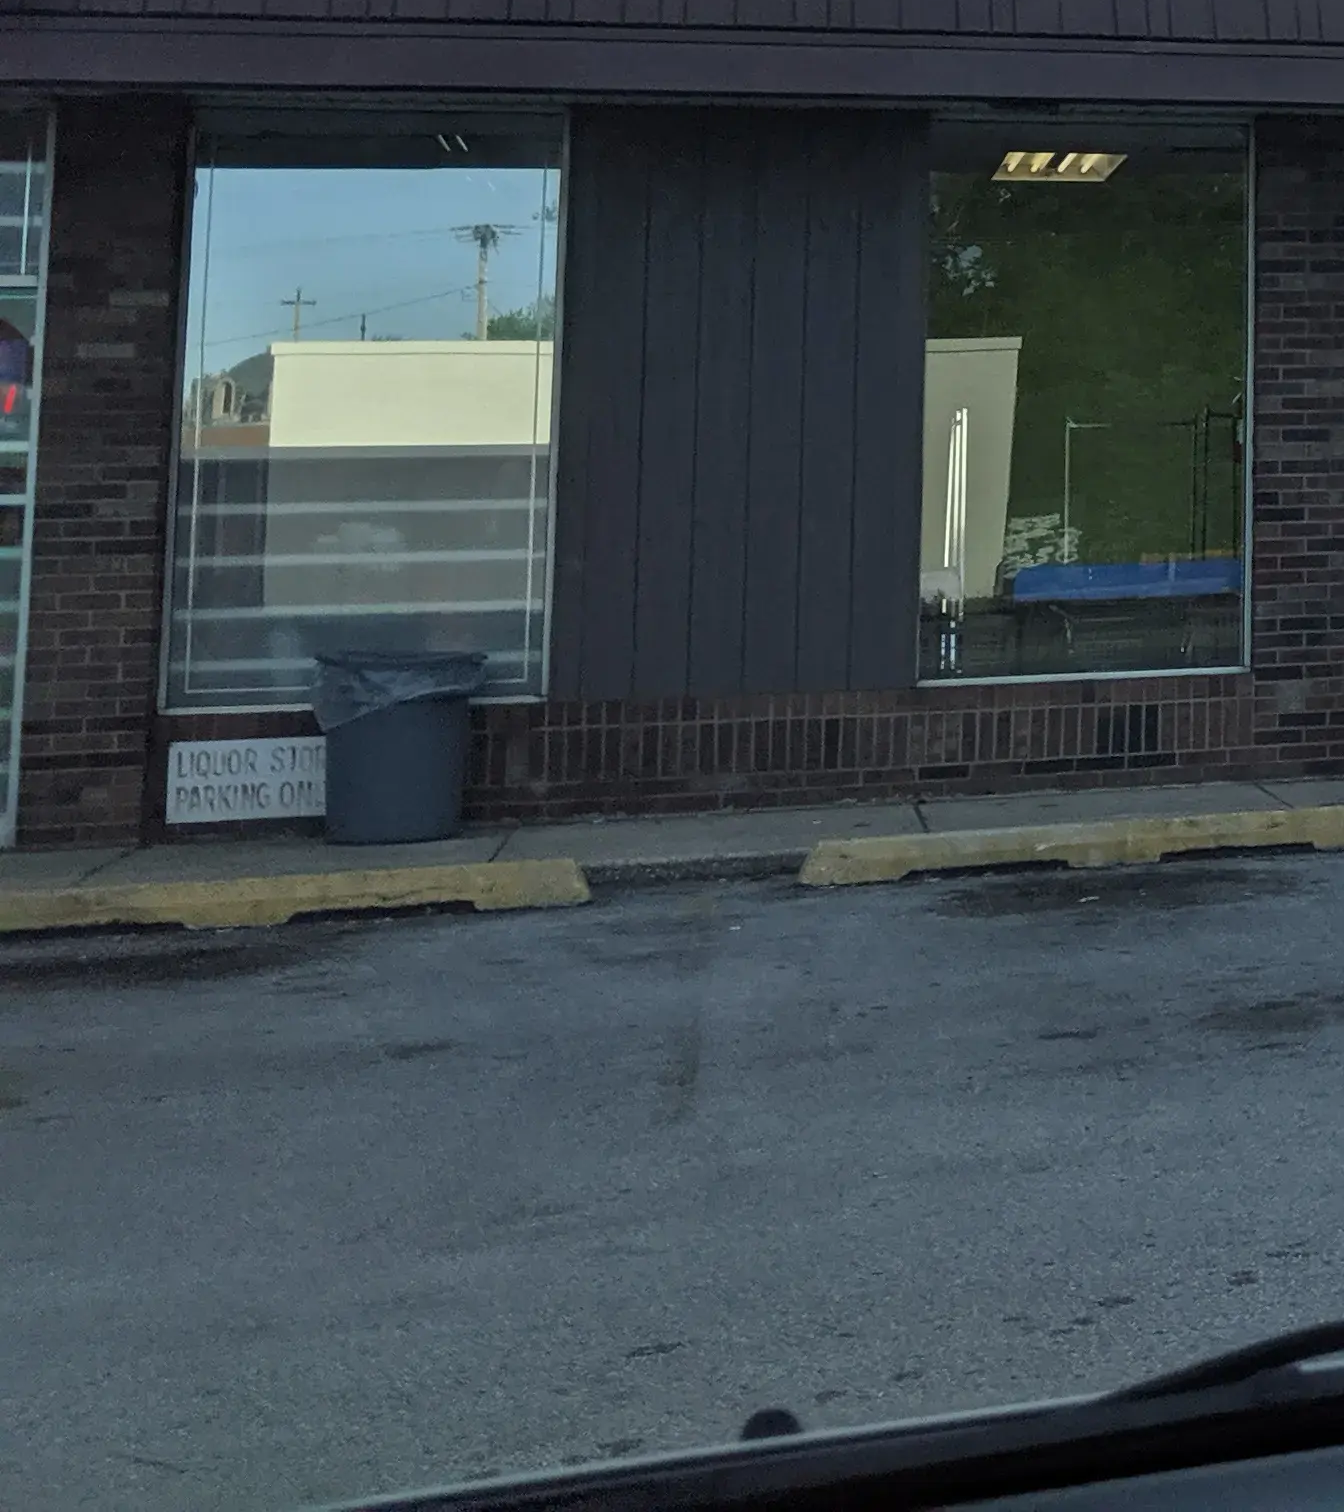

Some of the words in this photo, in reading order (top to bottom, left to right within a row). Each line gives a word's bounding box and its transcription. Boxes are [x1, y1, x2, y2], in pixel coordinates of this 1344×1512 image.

[177, 748, 258, 779] LIQUOR
[270, 745, 326, 775] STOR
[175, 781, 271, 813] PARKING
[280, 780, 326, 809] ONL
